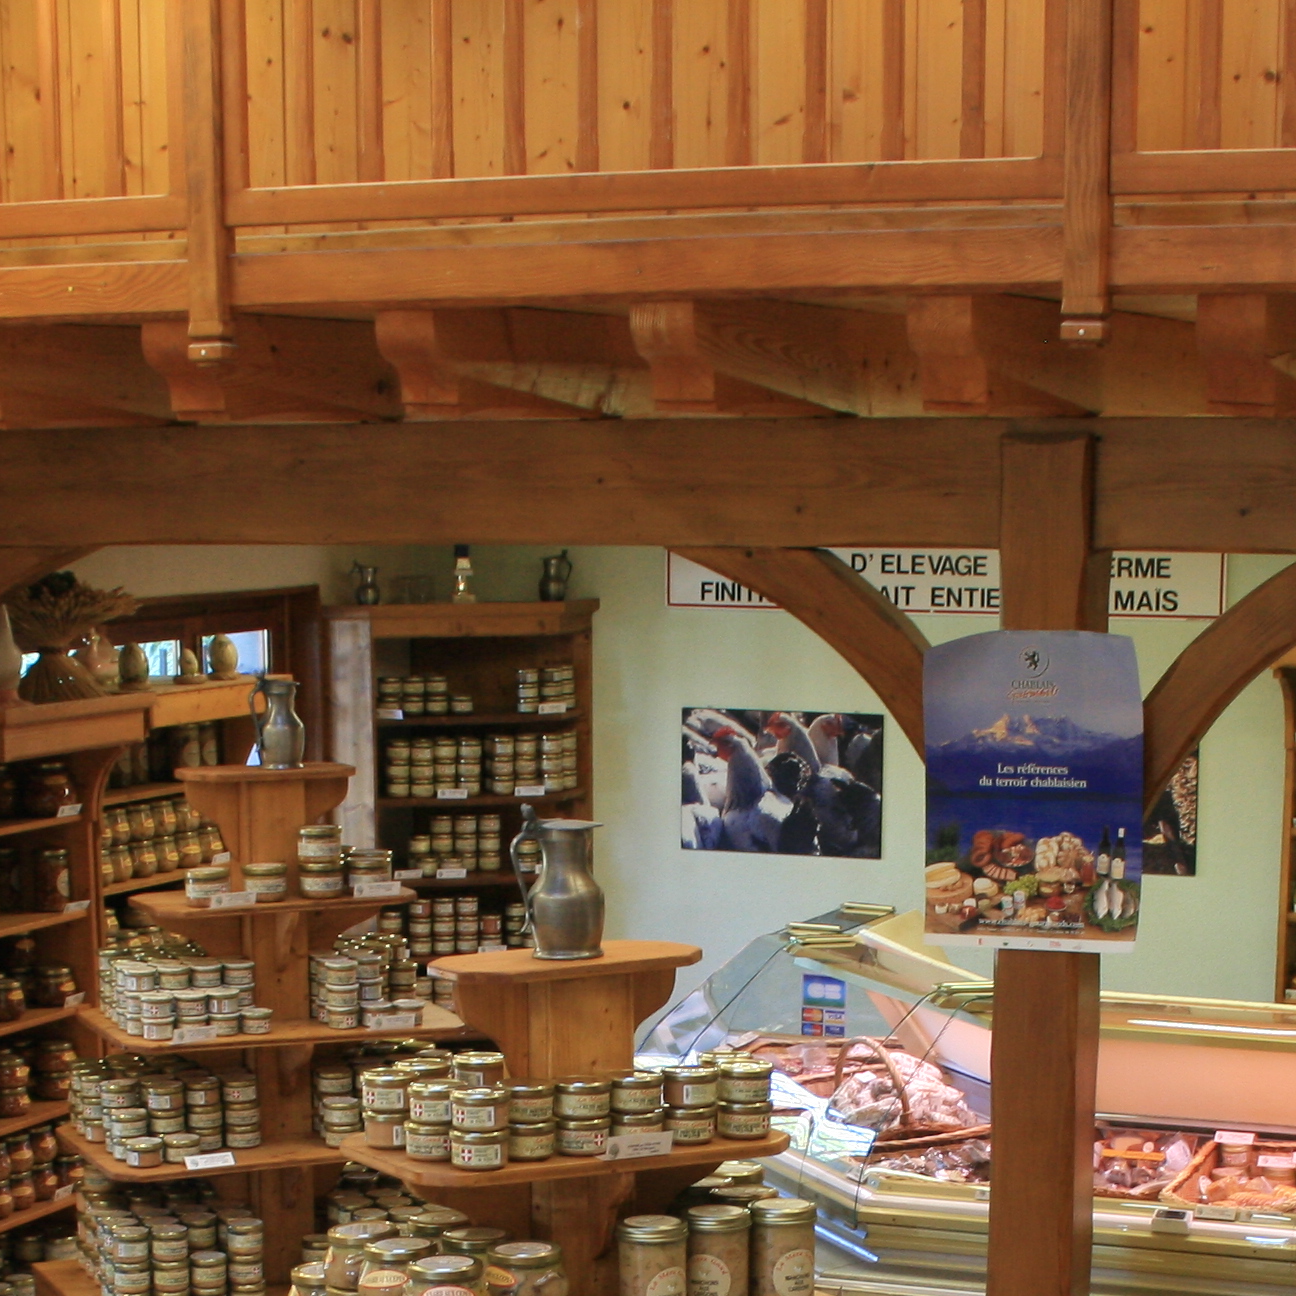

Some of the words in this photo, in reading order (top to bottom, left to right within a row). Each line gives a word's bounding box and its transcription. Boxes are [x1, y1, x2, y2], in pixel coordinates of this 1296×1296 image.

[1114, 587, 1178, 612] MAÏS
[997, 763, 1014, 774] Les
[1017, 763, 1068, 775] références
[979, 775, 992, 786] du
[995, 777, 1028, 787] terroir
[1030, 776, 1087, 788] chablaisien
